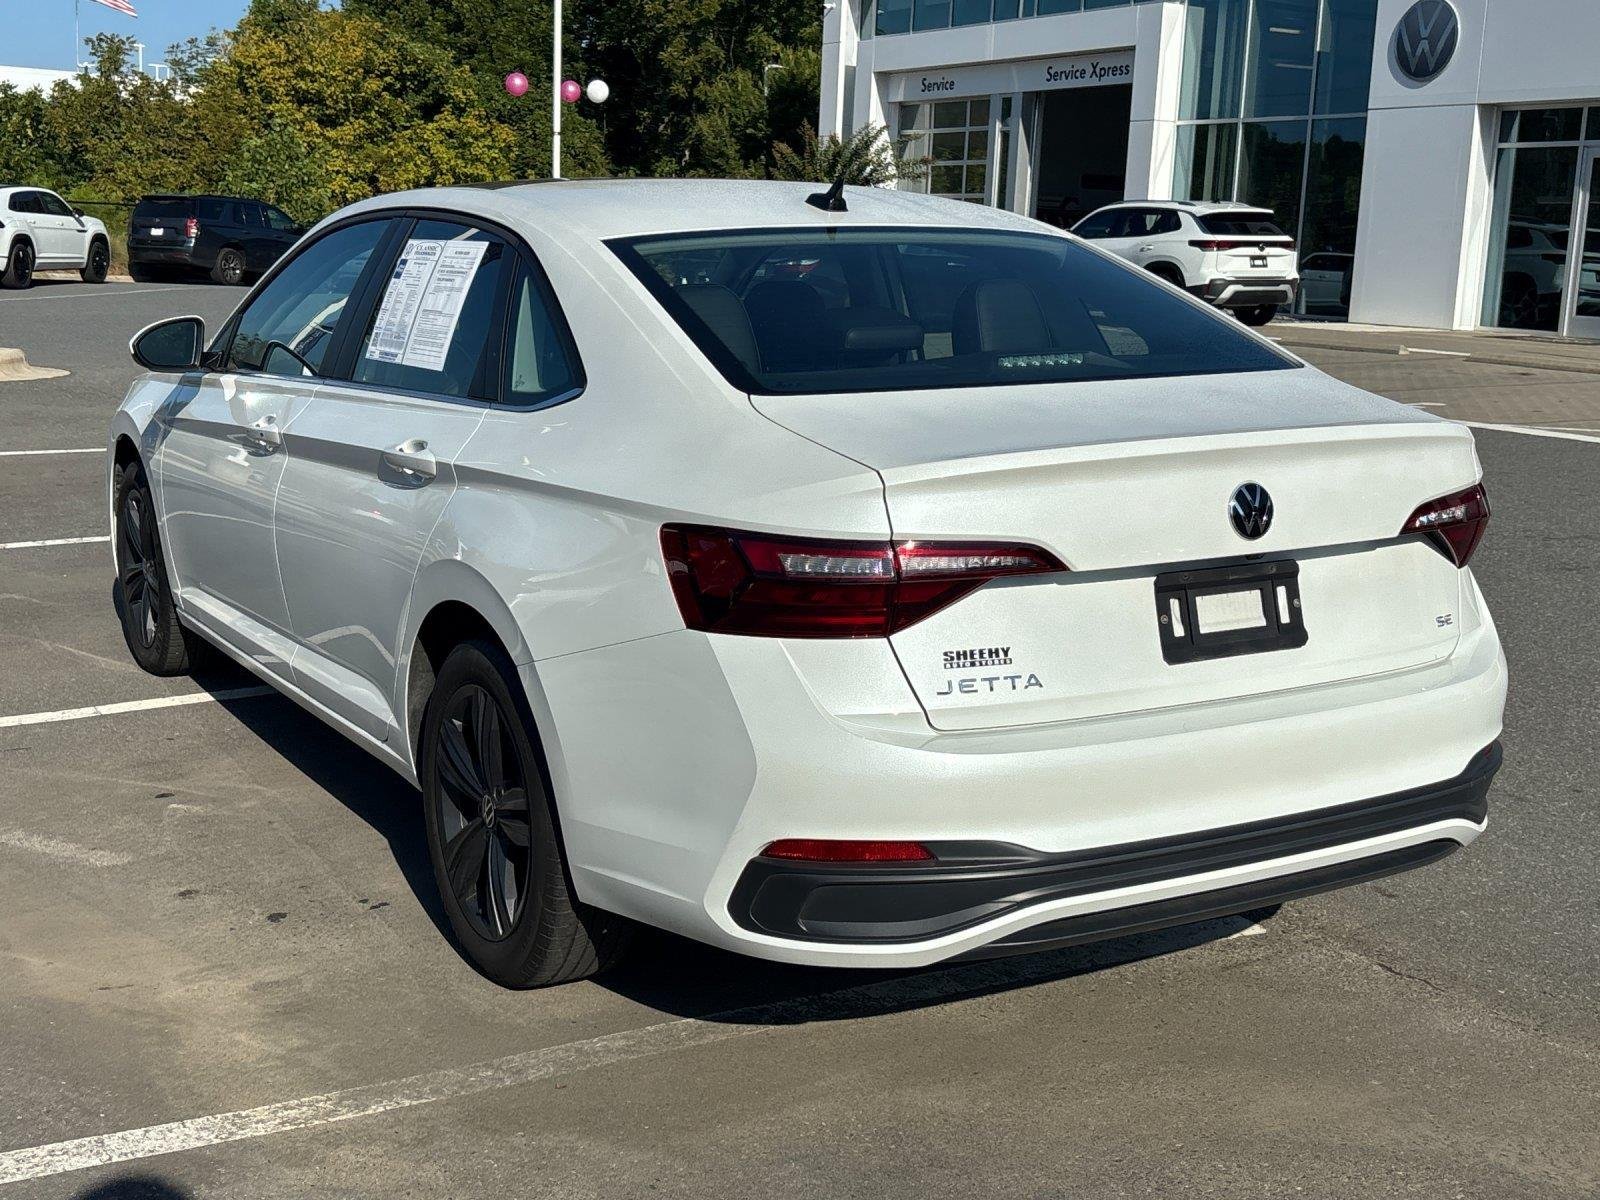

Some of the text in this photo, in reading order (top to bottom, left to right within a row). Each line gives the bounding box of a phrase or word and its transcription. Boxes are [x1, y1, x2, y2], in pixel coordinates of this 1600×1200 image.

[1397, 1, 1457, 76] VW
[1045, 61, 1130, 83] Service Xpress
[921, 77, 955, 93] Service
[1229, 482, 1273, 538] VW
[1435, 613, 1453, 628] SE
[942, 646, 1011, 662] SHEEHY
[944, 658, 1012, 669] AUTO STORES
[936, 673, 1043, 695] JETTA
